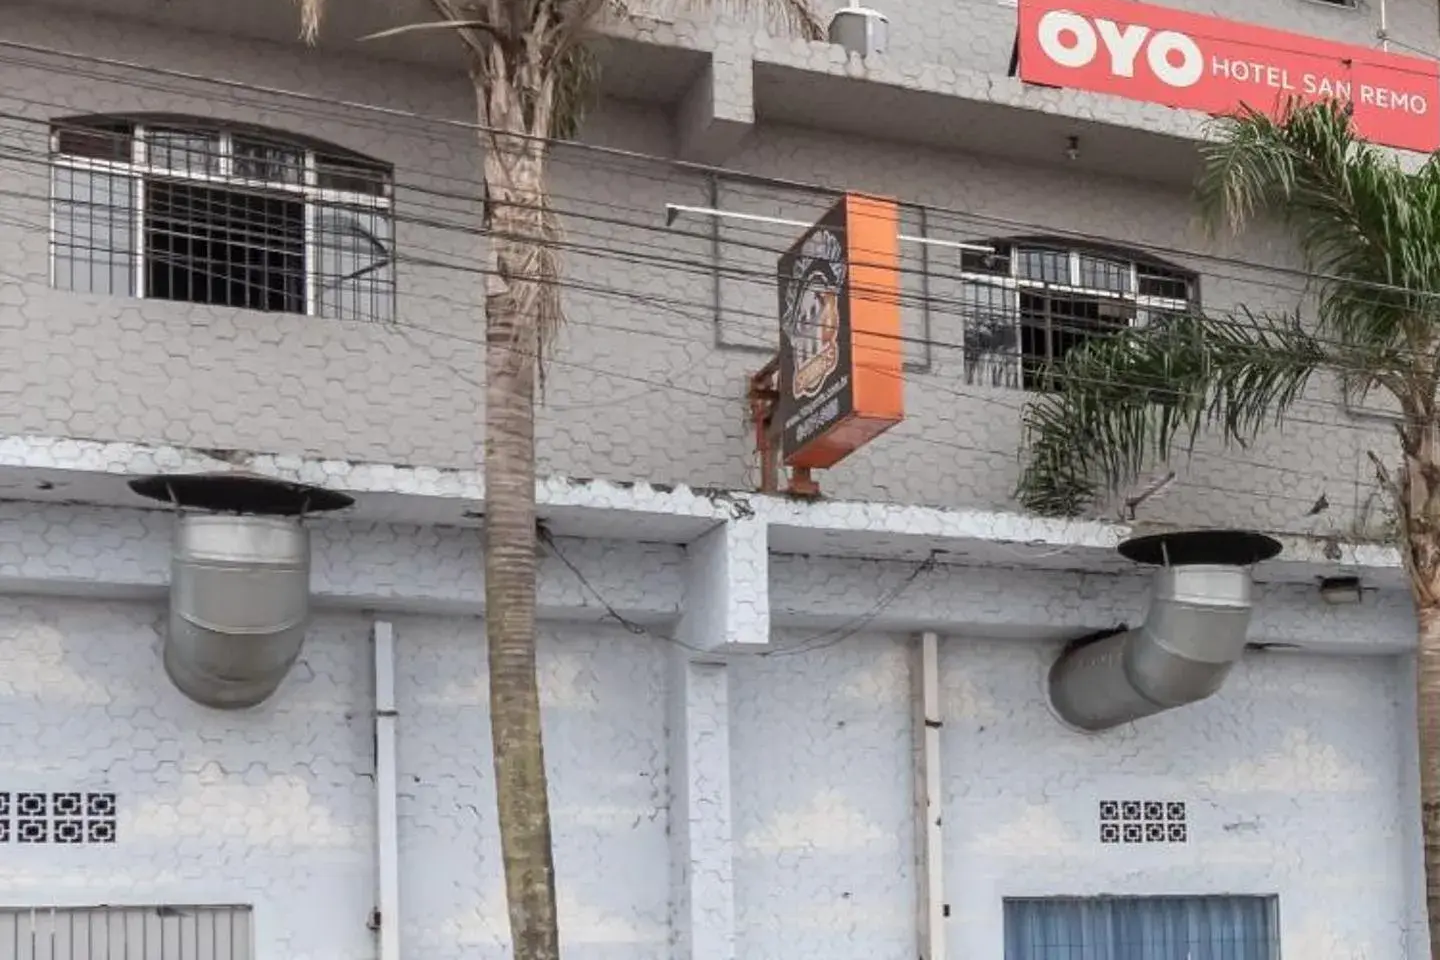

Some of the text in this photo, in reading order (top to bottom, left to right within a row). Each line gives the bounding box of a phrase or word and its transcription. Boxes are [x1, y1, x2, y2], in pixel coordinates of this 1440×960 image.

[1037, 9, 1428, 115] OYO HOTEL SAN REMO
